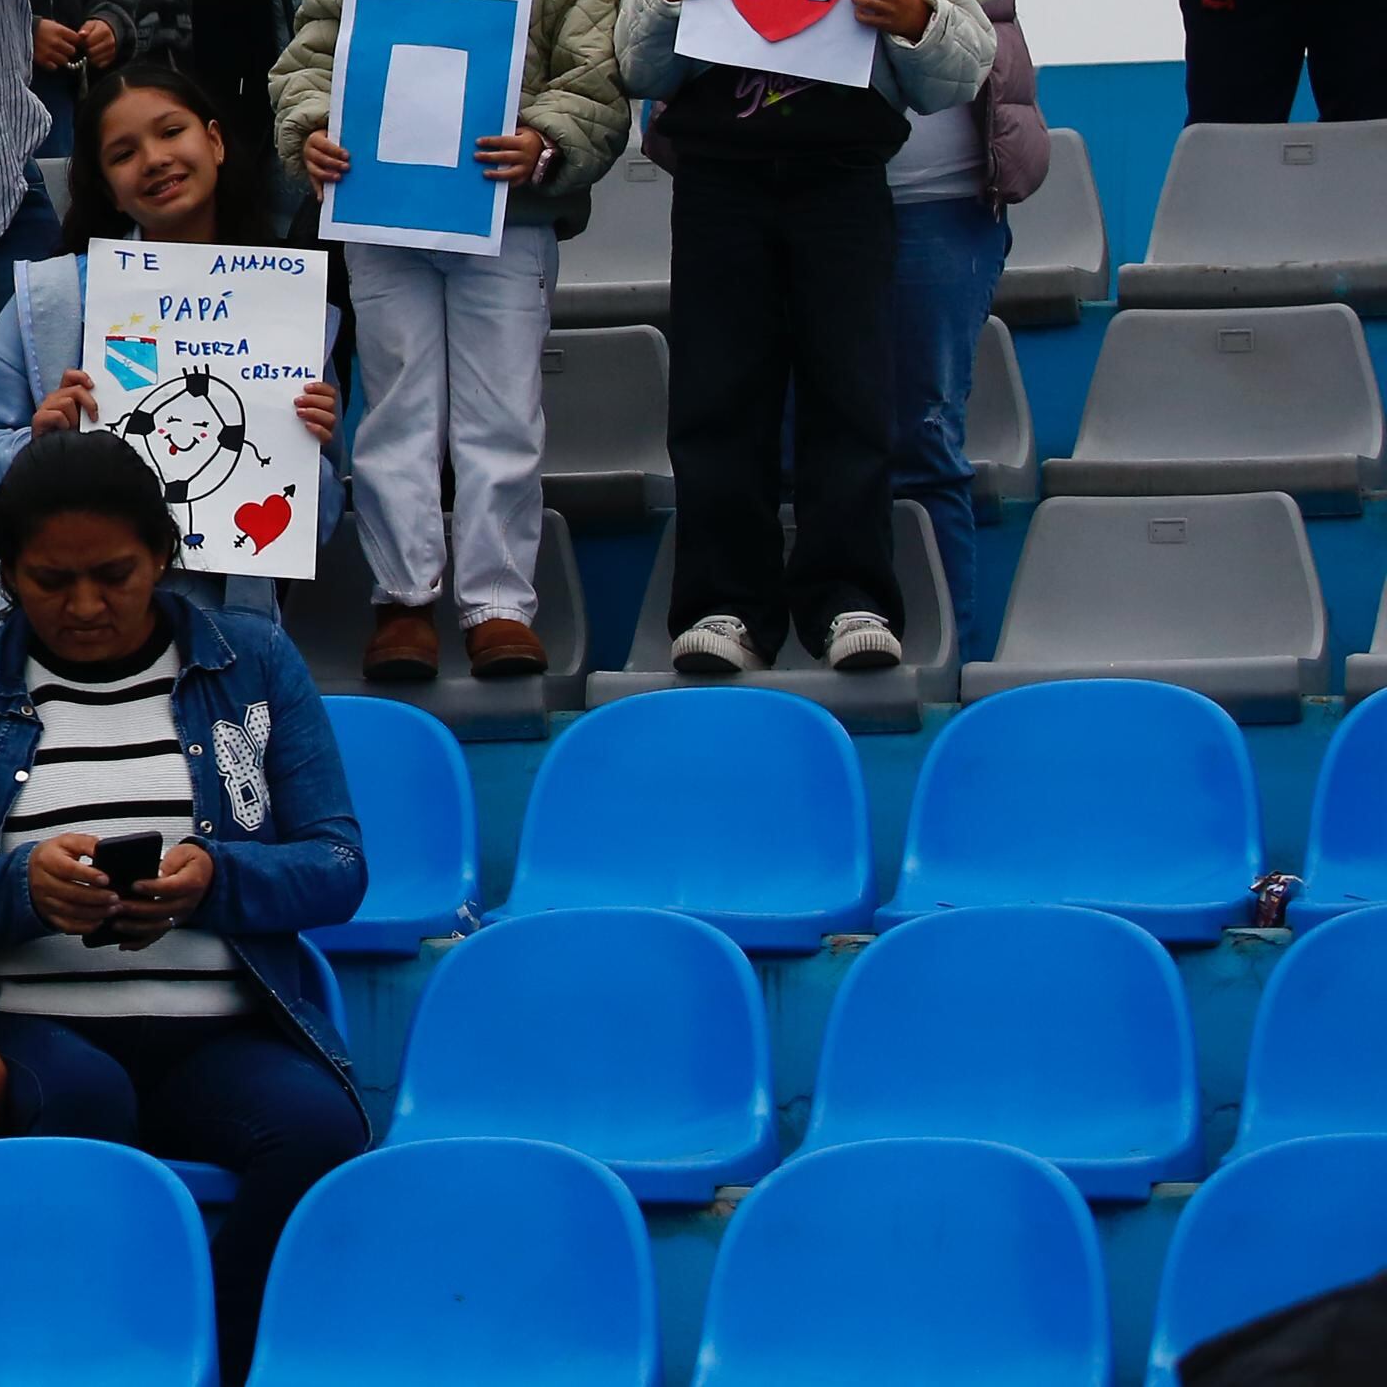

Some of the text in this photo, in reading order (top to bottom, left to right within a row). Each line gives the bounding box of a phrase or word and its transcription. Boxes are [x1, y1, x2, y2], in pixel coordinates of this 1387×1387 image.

[114, 250, 306, 275] TE AMAMOS
[158, 290, 233, 322] PAPÁ
[174, 338, 250, 356] FUERZA
[240, 362, 316, 380] CRISTAL
